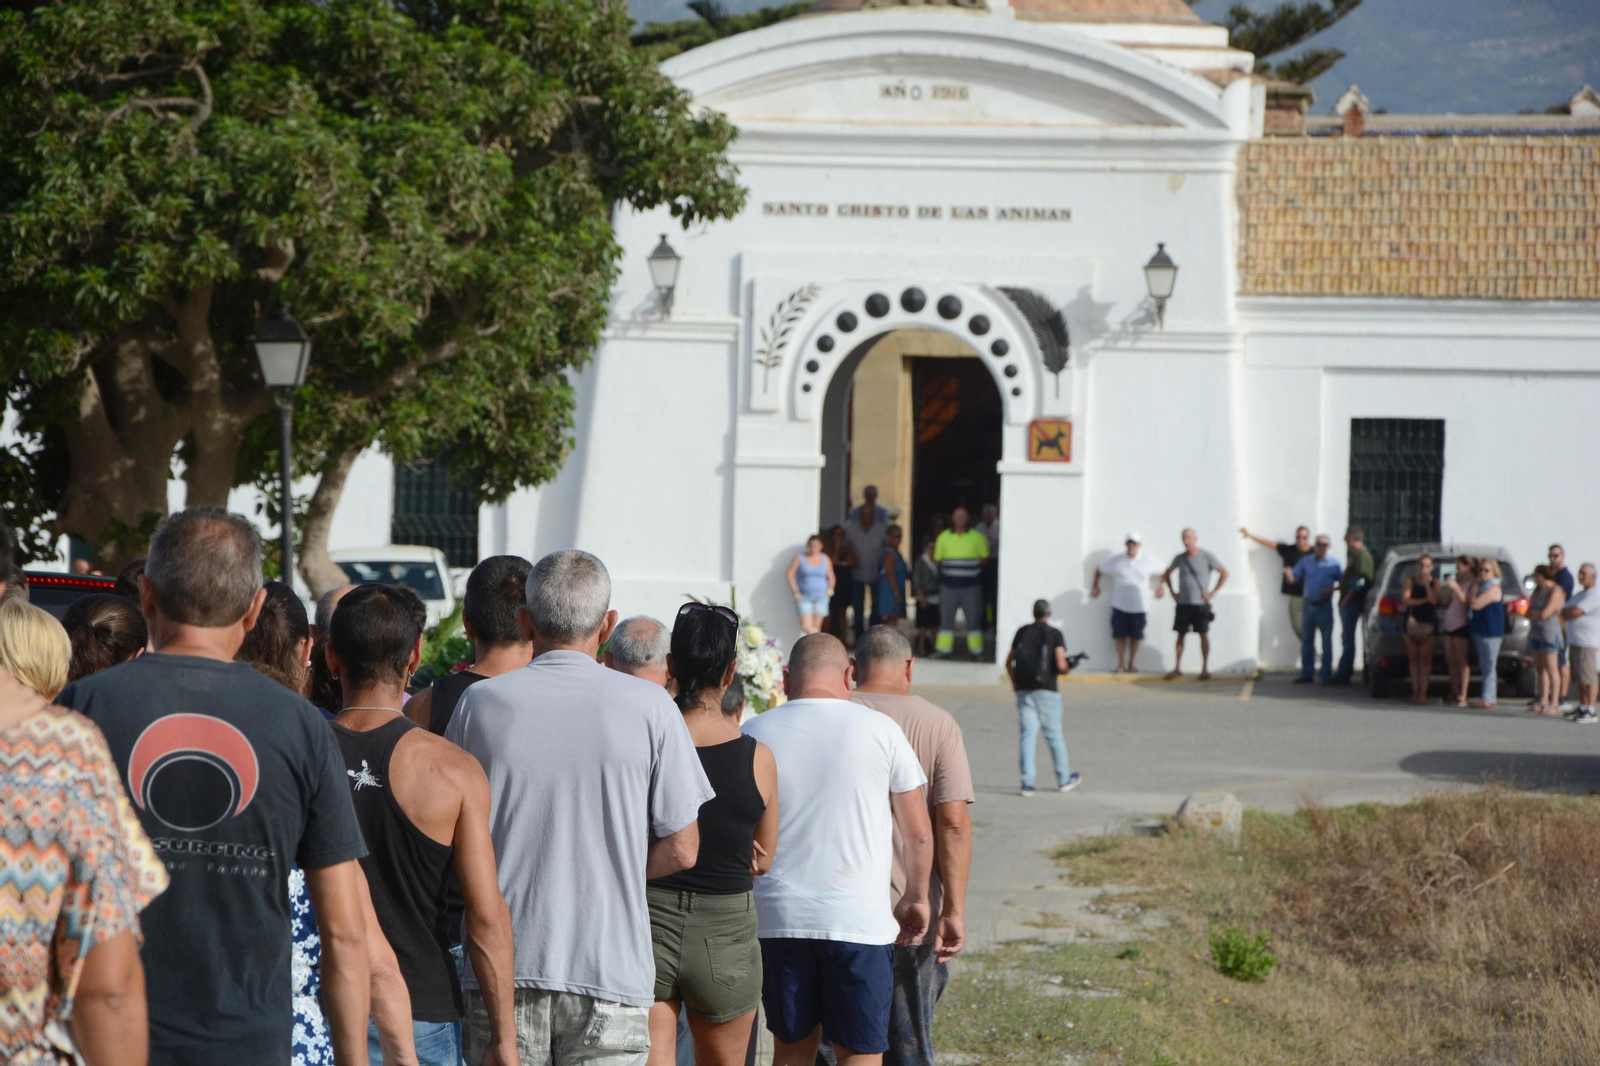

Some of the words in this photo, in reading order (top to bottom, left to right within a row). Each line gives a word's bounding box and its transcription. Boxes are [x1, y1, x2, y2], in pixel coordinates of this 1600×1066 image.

[763, 201, 829, 216] SANTO
[917, 204, 942, 219] DE
[951, 205, 989, 220] LAS
[997, 206, 1072, 221] ANIMAS
